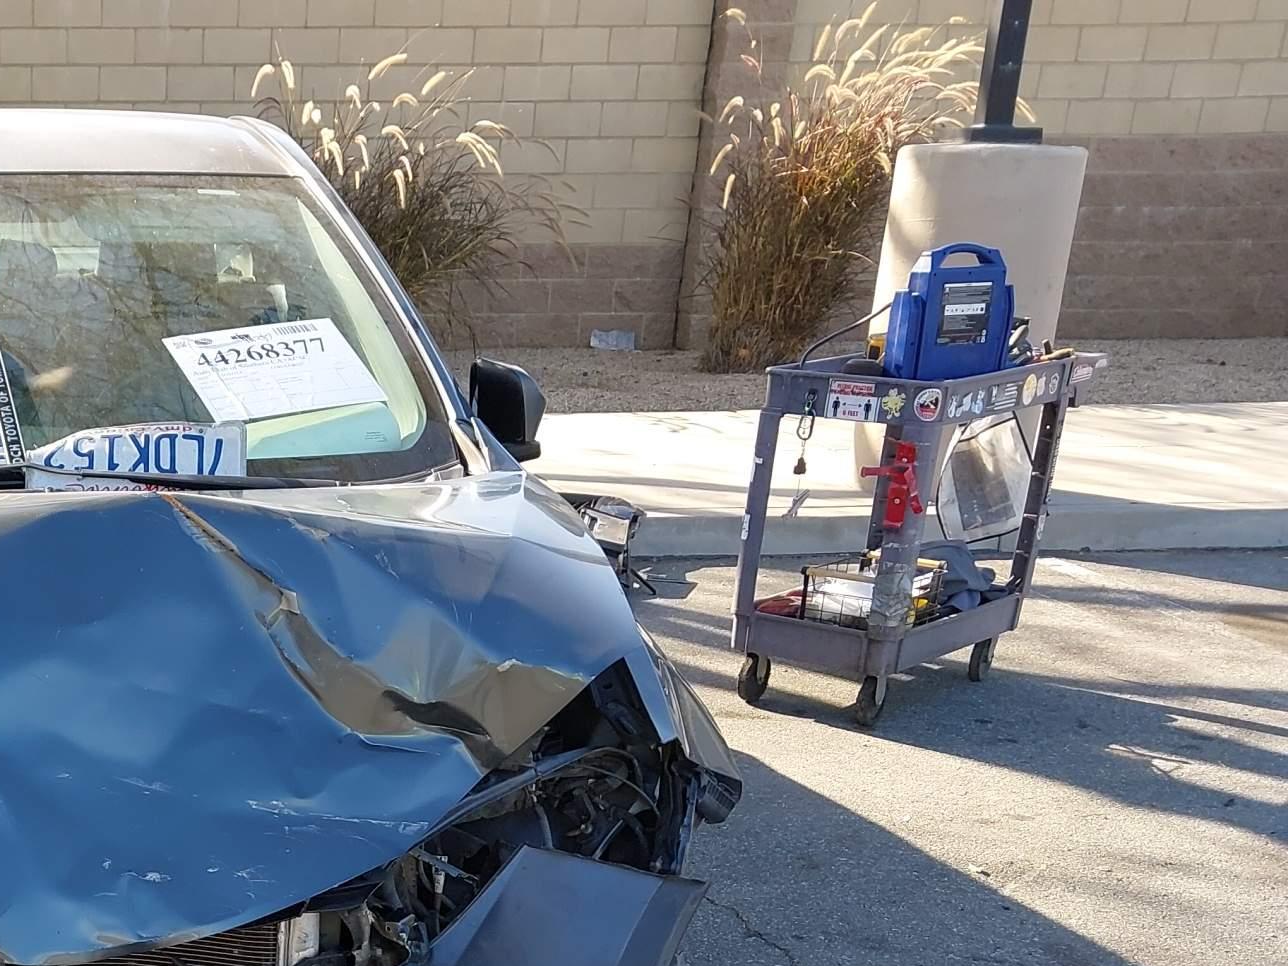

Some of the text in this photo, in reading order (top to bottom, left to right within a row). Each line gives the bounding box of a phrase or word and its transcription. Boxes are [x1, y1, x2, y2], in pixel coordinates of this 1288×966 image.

[196, 337, 326, 367] 44268377
[0, 406, 17, 442] TOYOTA
[10, 444, 24, 464] DCH
